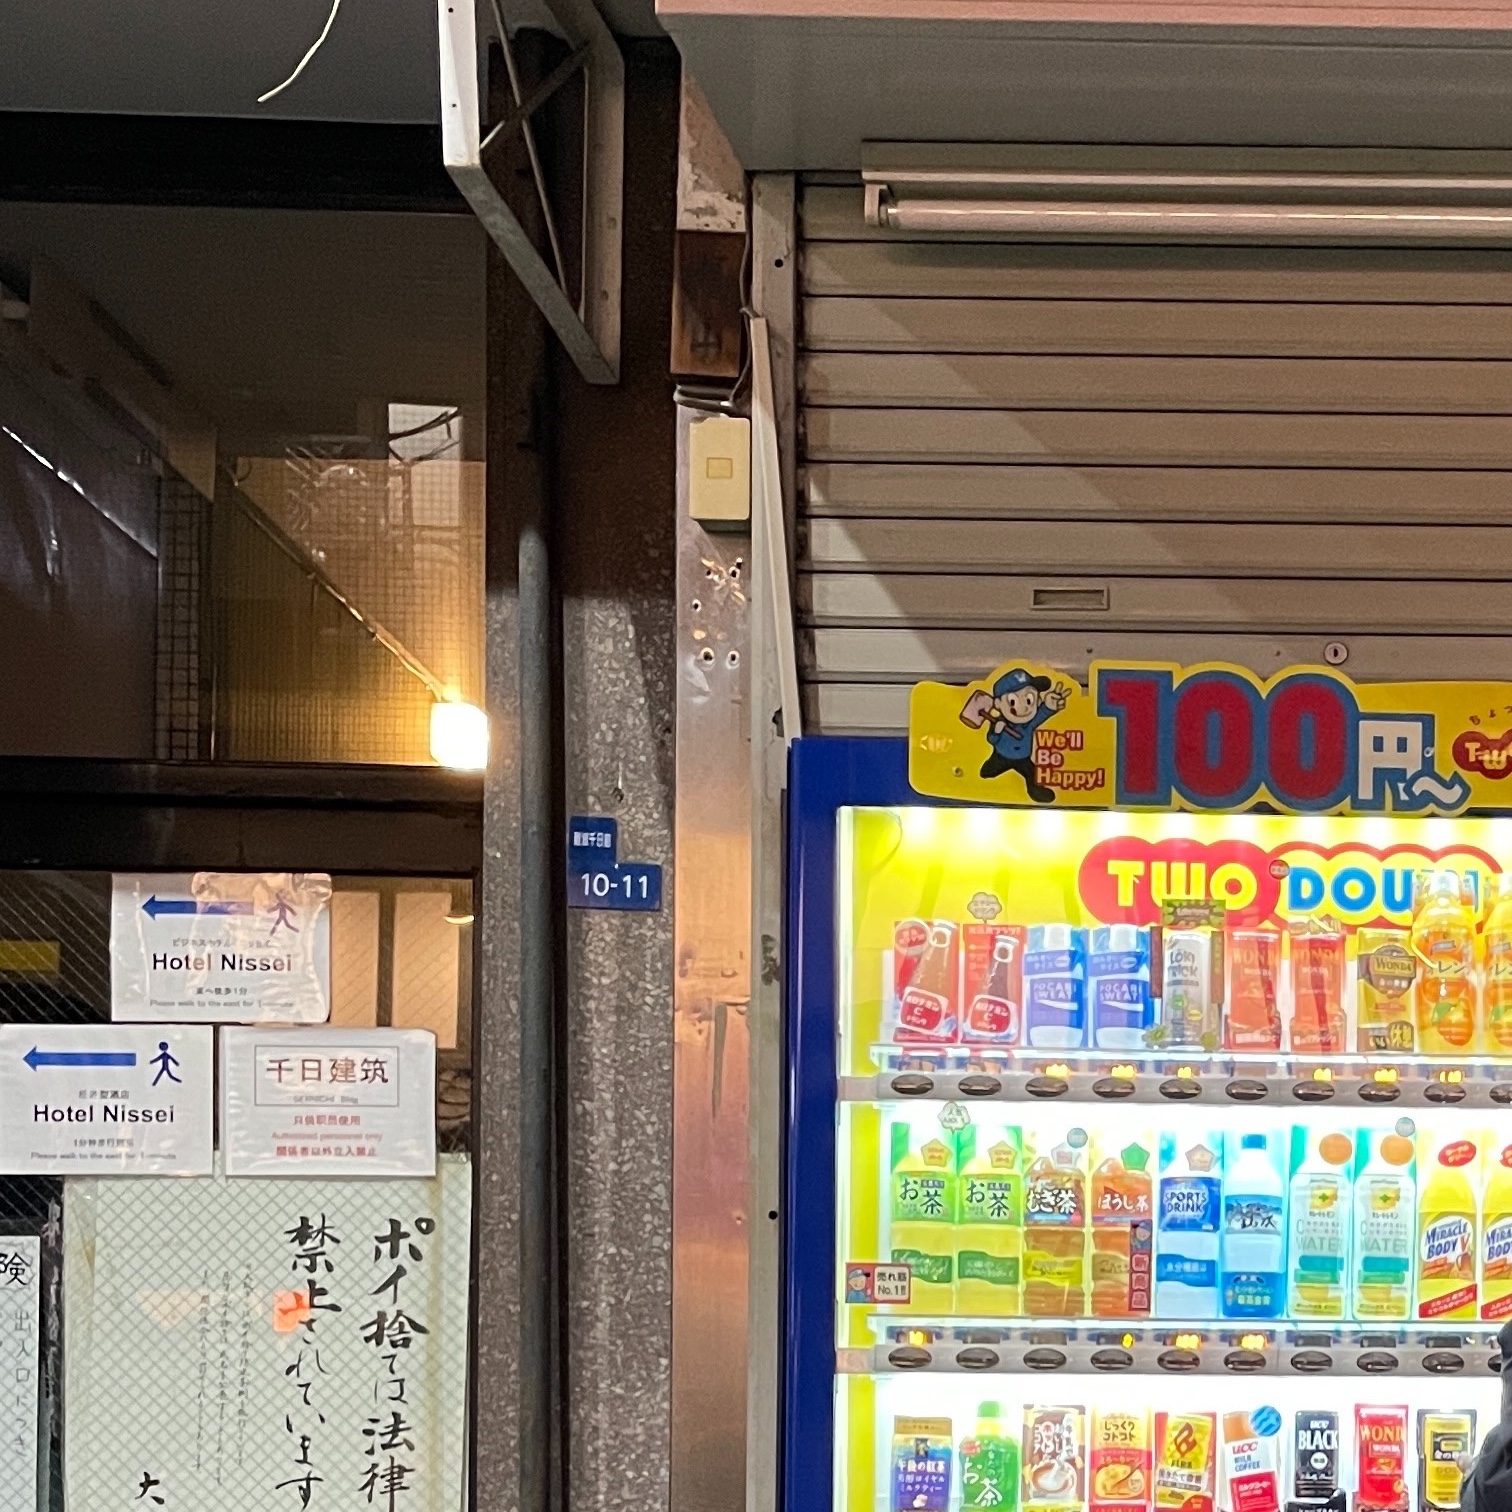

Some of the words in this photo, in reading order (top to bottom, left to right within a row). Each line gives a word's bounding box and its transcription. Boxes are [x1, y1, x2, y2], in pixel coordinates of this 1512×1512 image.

[1037, 731, 1083, 748] We'll
[1037, 749, 1062, 766] Be
[1037, 767, 1104, 788] Happy!
[581, 873, 648, 899] 10-11
[1107, 860, 1258, 911] TWO
[153, 953, 212, 971] Hotel
[221, 953, 292, 971] Nissei
[266, 1057, 389, 1084] 千日建筑
[34, 1105, 93, 1122] Hotel
[103, 1105, 174, 1122] Nissei
[1298, 1430, 1339, 1450] BLACK
